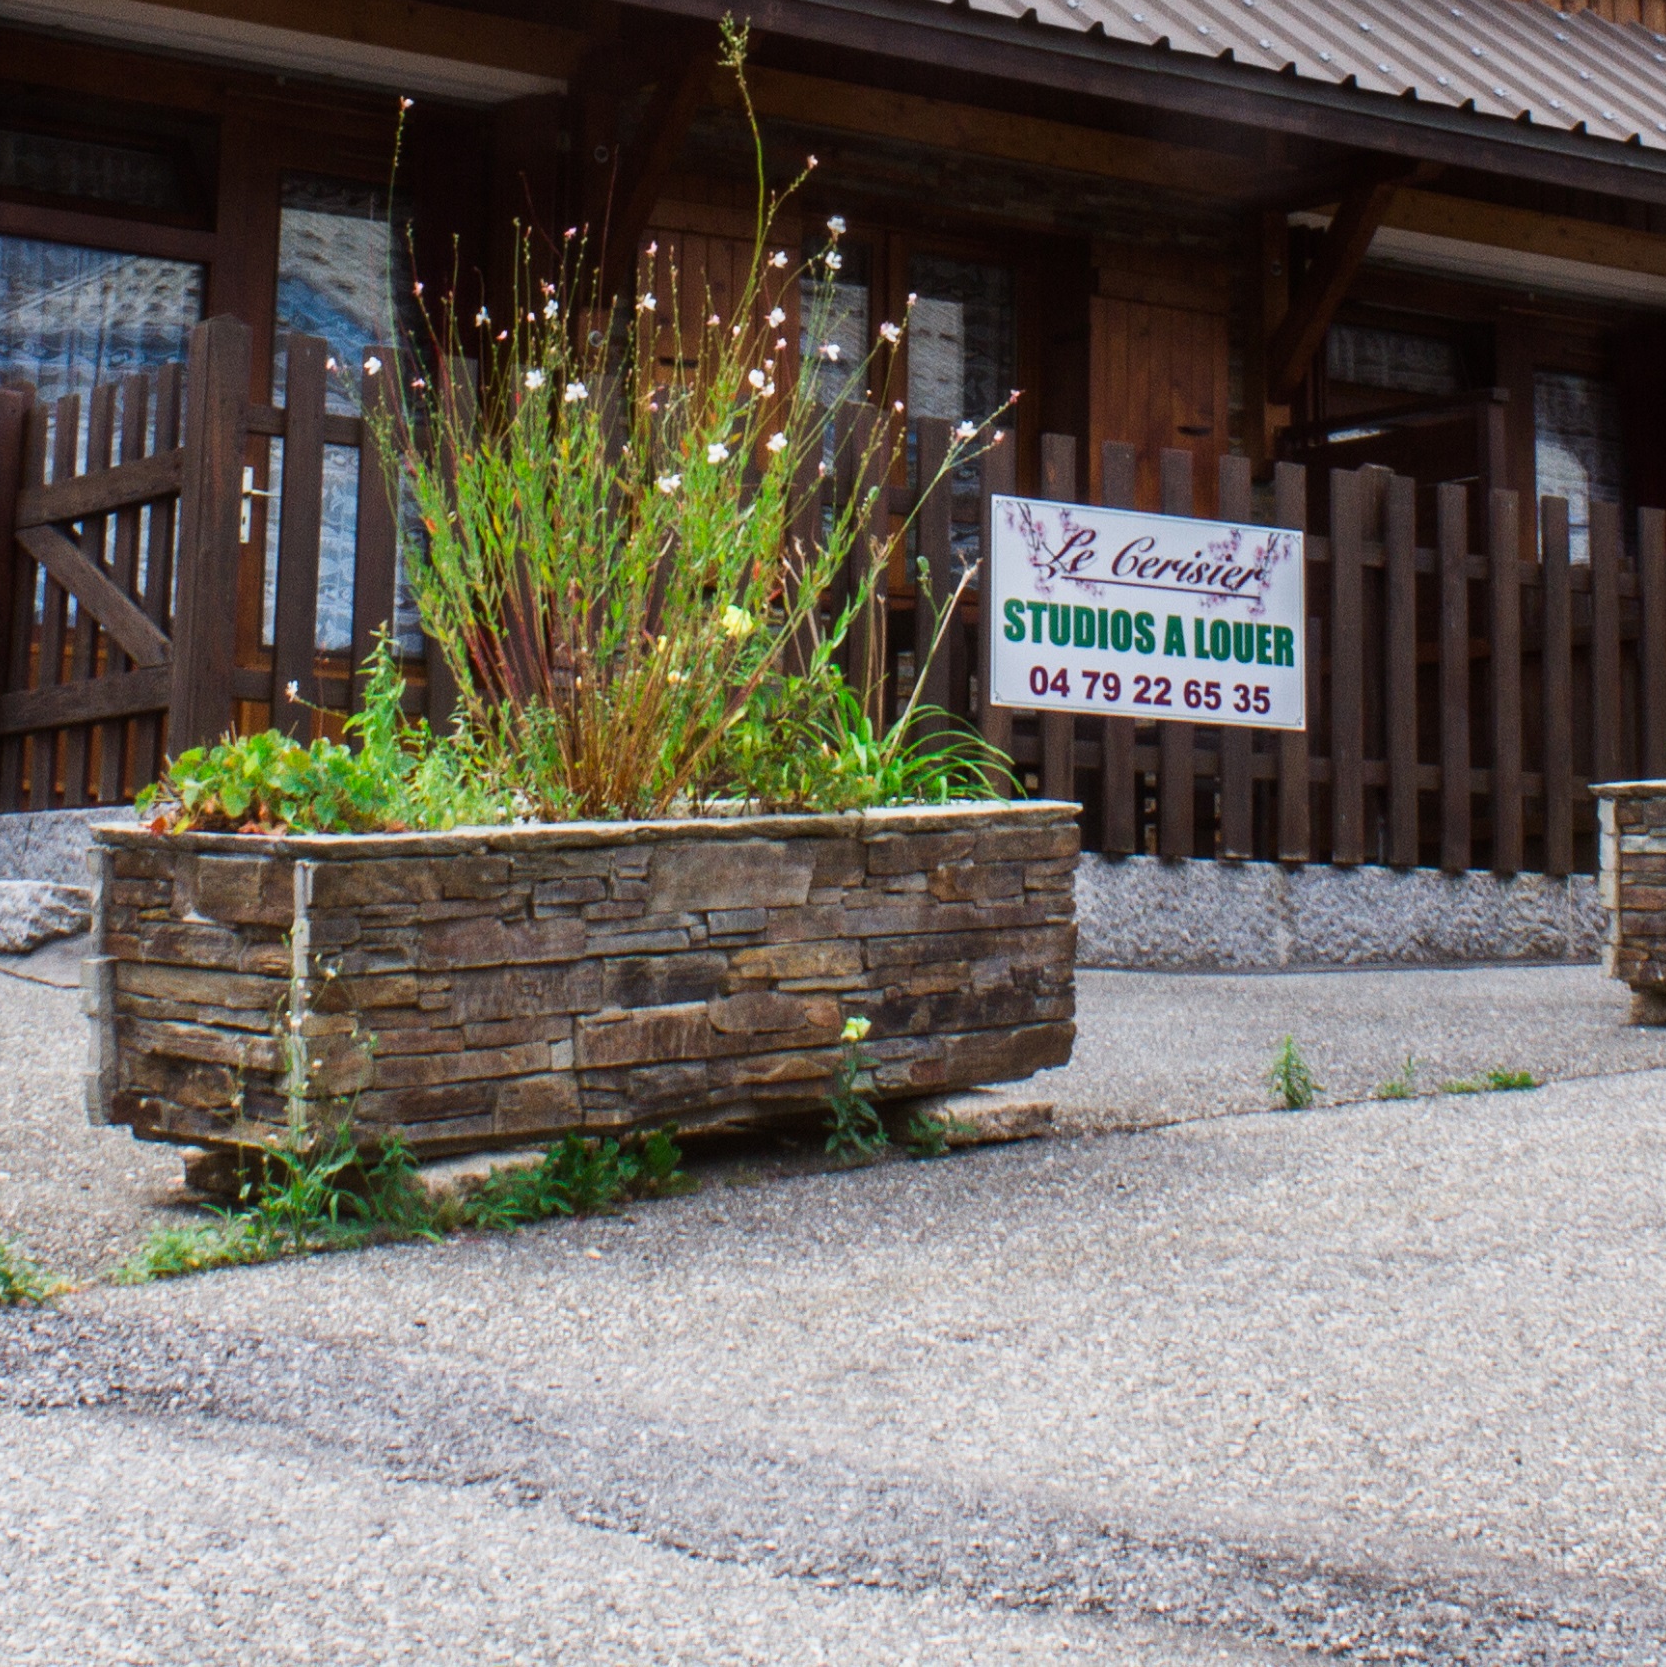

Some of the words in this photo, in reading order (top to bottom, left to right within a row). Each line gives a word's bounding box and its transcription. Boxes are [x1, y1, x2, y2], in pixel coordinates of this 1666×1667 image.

[1035, 529, 1097, 579] Le
[1112, 536, 1266, 591] Cerisier
[1004, 598, 1155, 655] STUDIOS
[1163, 615, 1186, 657] A
[1195, 617, 1294, 667] LOUER
[1030, 666, 1070, 698] 04
[1081, 670, 1122, 702] 79
[1133, 675, 1172, 706] 22
[1184, 679, 1222, 710] 65
[1233, 684, 1270, 714] 35
